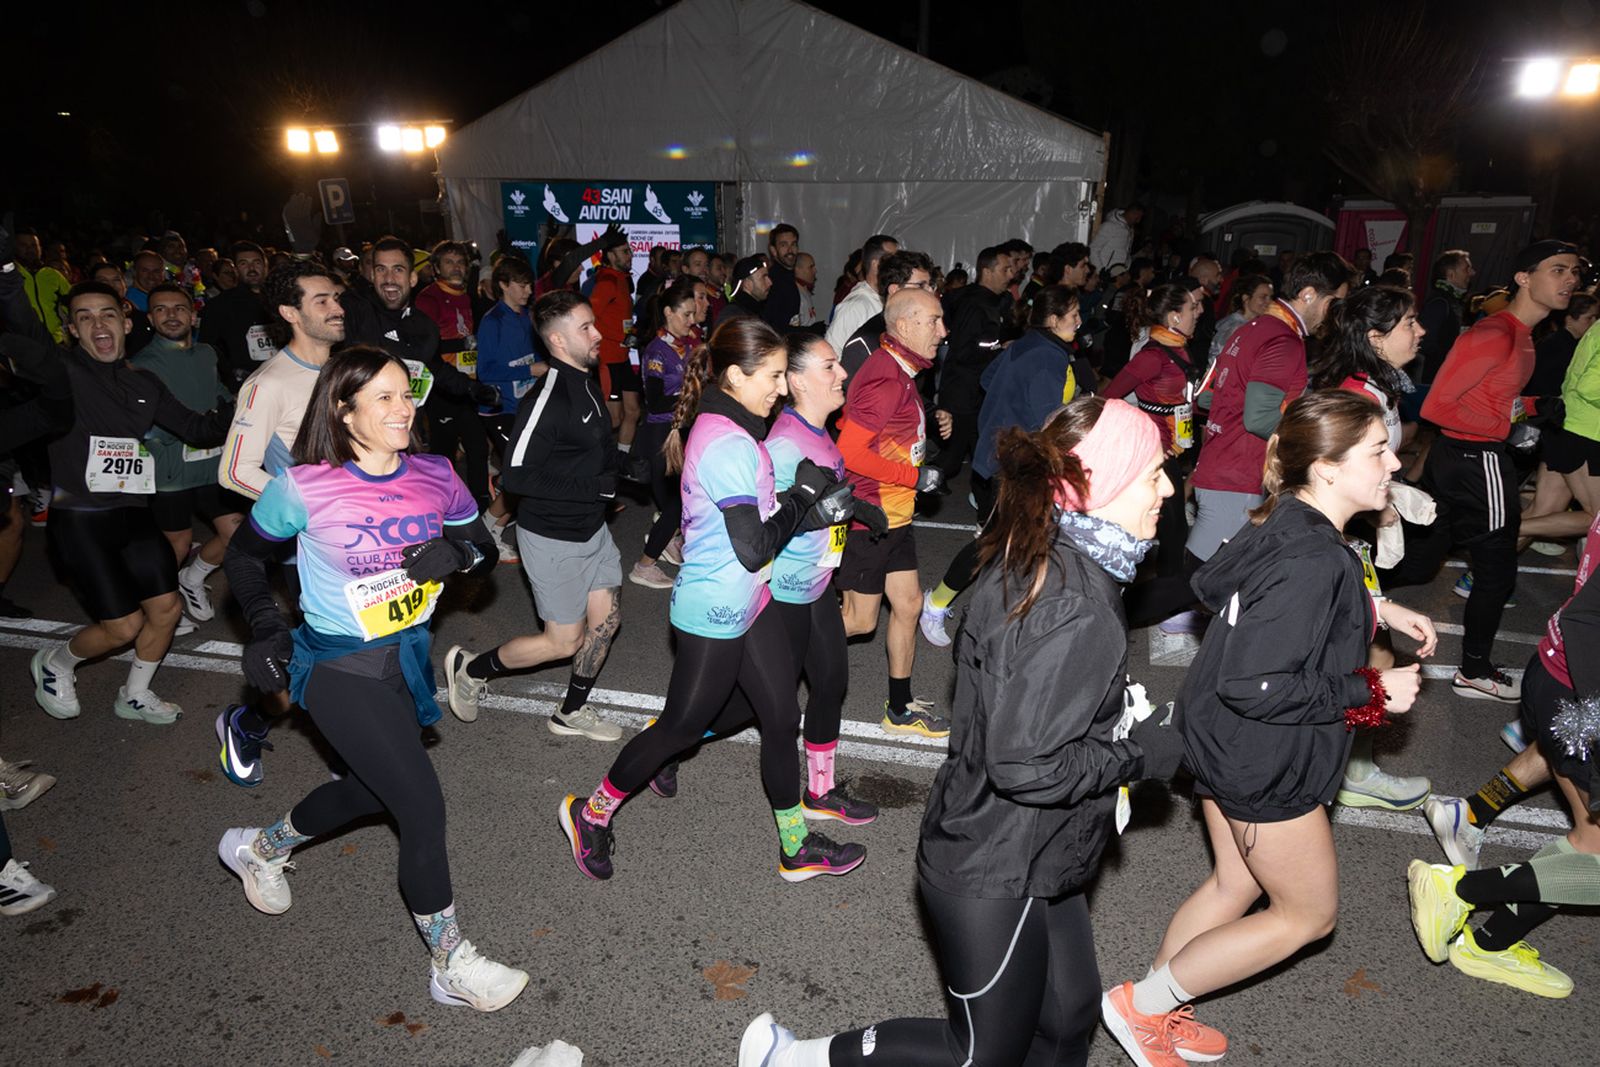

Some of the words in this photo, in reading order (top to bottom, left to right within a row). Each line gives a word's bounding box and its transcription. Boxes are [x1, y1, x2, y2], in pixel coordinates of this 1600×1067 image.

[582, 187, 600, 205] 43
[601, 188, 632, 204] SAN
[551, 205, 560, 216] 43
[579, 202, 631, 220] ANTÓN
[652, 206, 662, 217] 43
[630, 241, 653, 252] SAN
[97, 449, 113, 457] SAN
[102, 457, 143, 475] 2976
[346, 554, 381, 565] CLUB
[370, 576, 399, 593] NOCHE
[364, 594, 384, 608] SAN
[388, 587, 424, 622] 419
